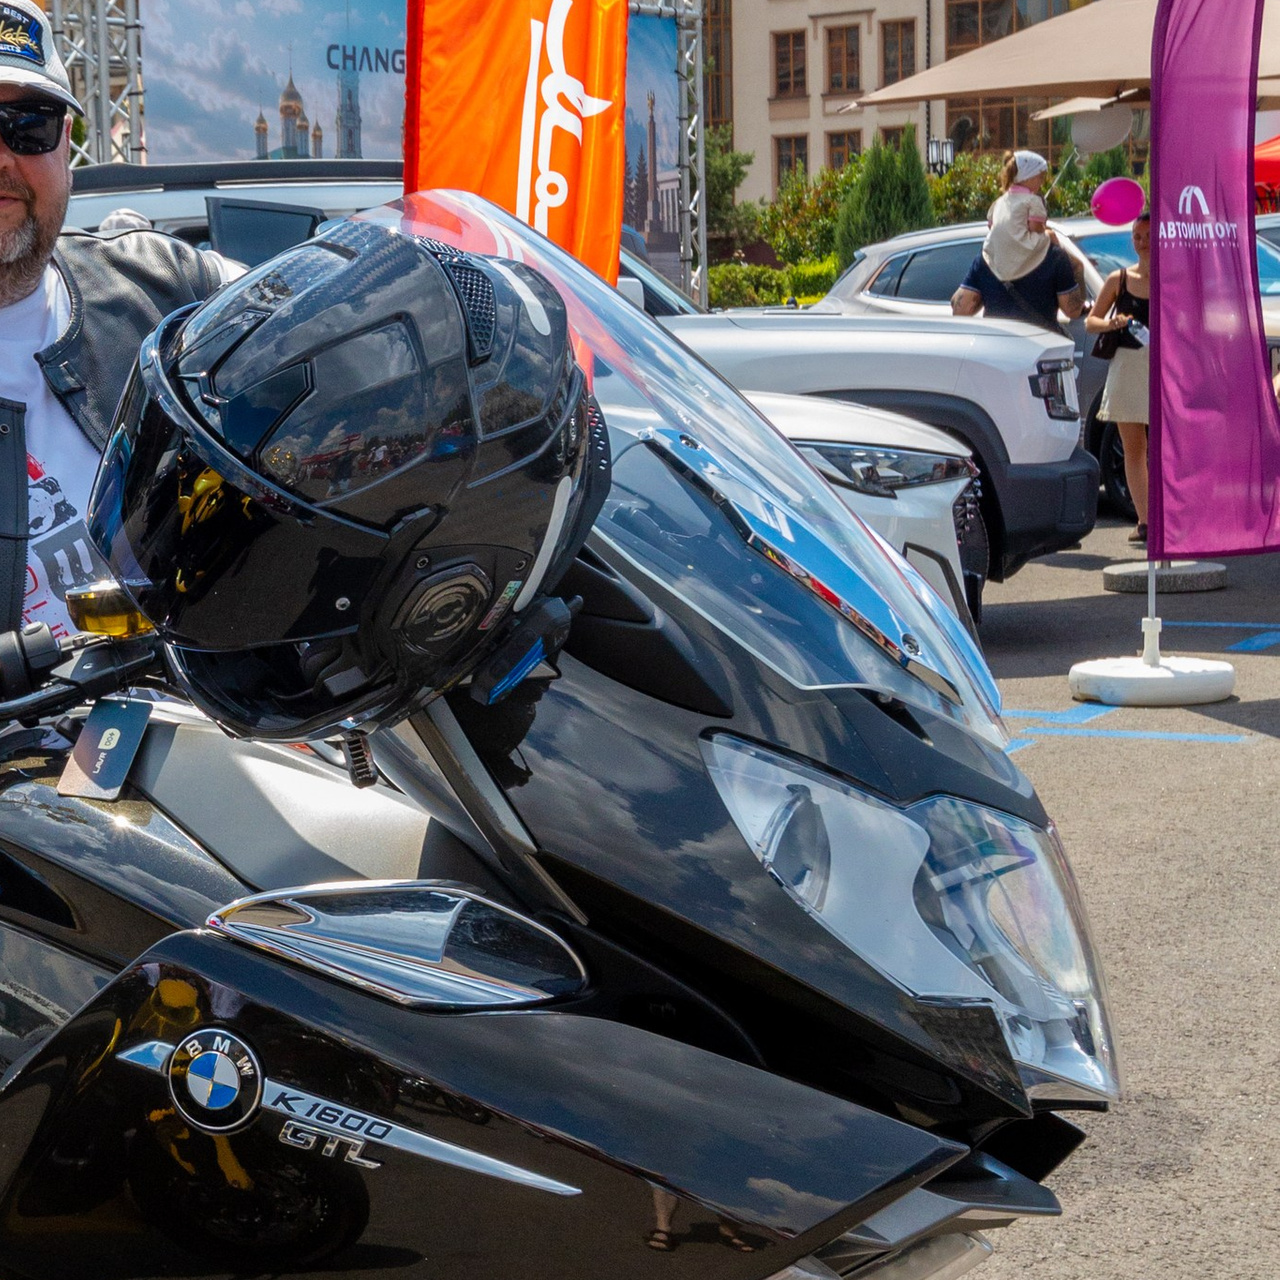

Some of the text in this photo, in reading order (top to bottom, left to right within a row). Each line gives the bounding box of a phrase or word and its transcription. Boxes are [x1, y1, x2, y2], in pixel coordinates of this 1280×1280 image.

[3, 7, 29, 24] BEST
[327, 44, 405, 74] CHANG
[185, 1036, 255, 1077] BMW
[278, 1120, 386, 1170] GTL
